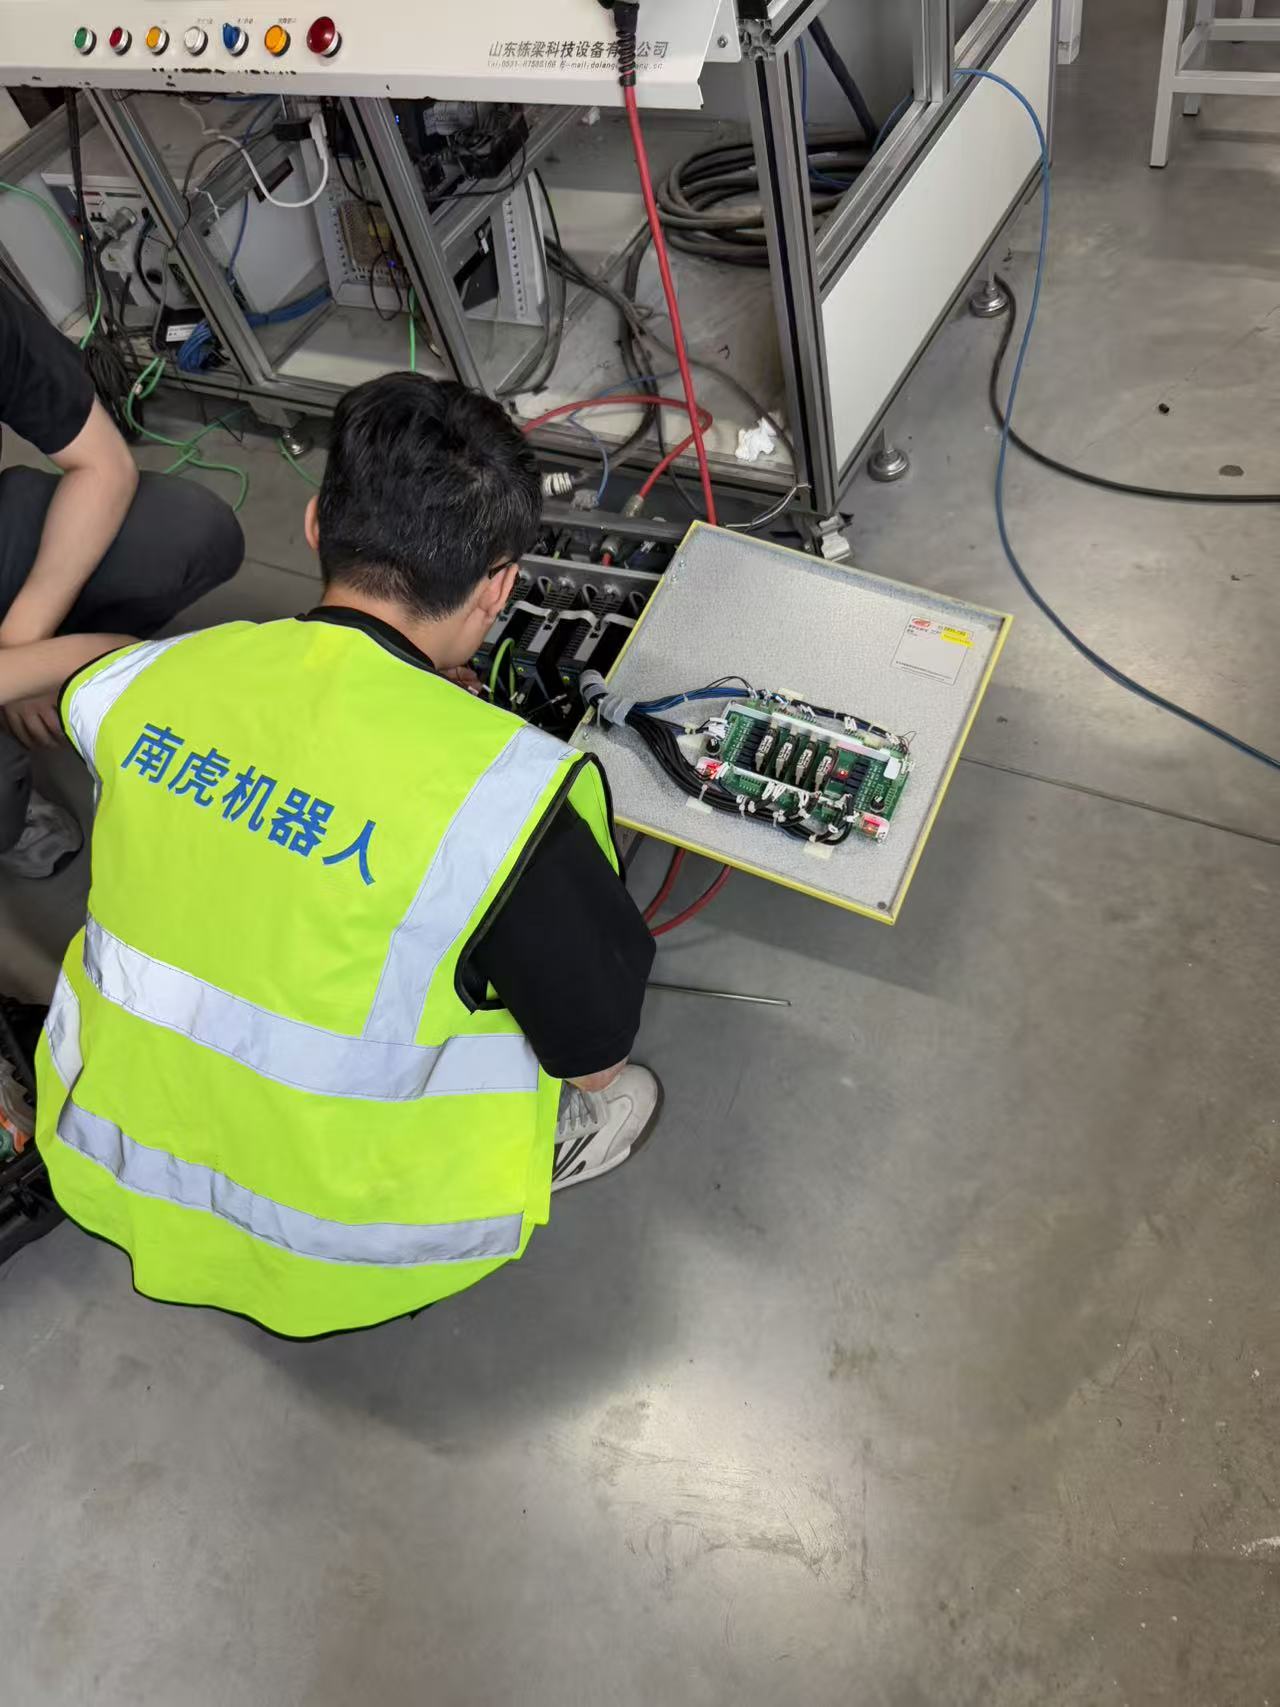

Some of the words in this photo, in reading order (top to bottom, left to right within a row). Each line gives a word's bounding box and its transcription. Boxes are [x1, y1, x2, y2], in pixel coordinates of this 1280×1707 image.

[488, 41, 668, 58] 山东栋梁科技设备有公司
[120, 723, 376, 886] 南虎机器人
